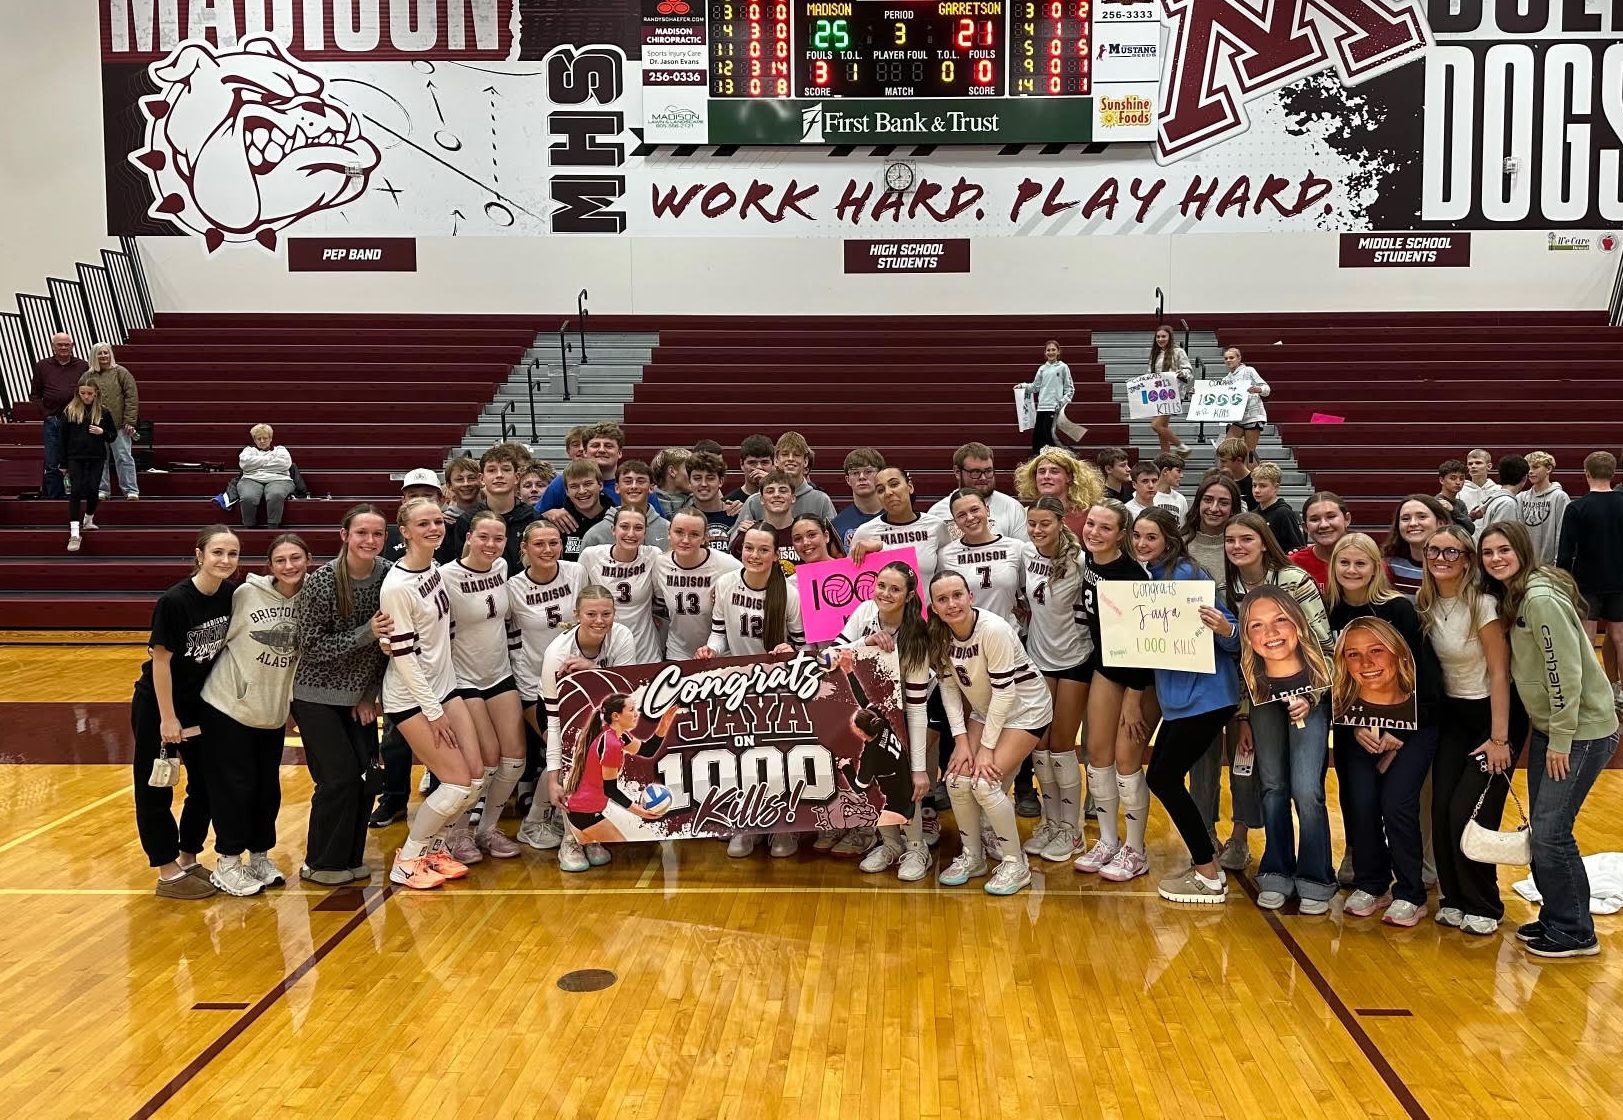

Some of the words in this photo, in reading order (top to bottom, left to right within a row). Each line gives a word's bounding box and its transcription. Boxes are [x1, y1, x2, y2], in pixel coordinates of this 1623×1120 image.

[724, 4, 733, 20] 3
[750, 4, 760, 20] 0
[776, 4, 787, 20] 0
[806, 3, 851, 16] MADISON
[884, 10, 914, 19] PERIOD
[937, 2, 1001, 16] GARRETSON
[1026, 3, 1034, 18] 3
[1052, 2, 1061, 18] 0
[1079, 2, 1089, 18] 2
[1102, 10, 1153, 18] 256-3333
[723, 24, 733, 37] 4
[751, 22, 760, 39] 3
[776, 22, 787, 39] 0
[814, 19, 849, 48] 25
[894, 22, 906, 44] 3
[958, 18, 992, 47] 21
[1024, 22, 1034, 36] 4
[718, 43, 733, 56] 11
[750, 41, 760, 58] 0
[776, 41, 787, 58] 0
[806, 50, 833, 60] FOULS
[840, 50, 863, 60] T.O.L.
[873, 50, 905, 60] PLAYER
[907, 50, 928, 60] FOUL
[936, 50, 960, 60] T.O.L.
[968, 50, 996, 60] FOULS
[1024, 40, 1034, 55] 5
[1051, 39, 1061, 55] 0
[1078, 39, 1088, 55] 5
[1108, 44, 1156, 54] MUSTANG
[718, 60, 733, 76] 12
[751, 60, 760, 76] 3
[771, 61, 787, 75] 14
[814, 59, 828, 83] 3
[941, 60, 955, 82] 0
[978, 60, 992, 82] 0
[1024, 59, 1034, 72] 9
[1051, 58, 1061, 73] 0
[649, 72, 700, 82] 256-0336
[1018, 79, 1034, 91] 14
[1051, 77, 1061, 93] 0
[718, 79, 734, 94] 13
[751, 78, 761, 94] 0
[777, 78, 787, 94] 8
[804, 87, 831, 96] SCORE
[885, 87, 914, 96] MATCH
[968, 86, 995, 96] SCORE
[1101, 98, 1150, 110] Sunshine
[824, 111, 870, 132] First
[874, 111, 928, 132] Bank
[931, 116, 946, 132] &
[946, 112, 1000, 132] Trust
[1118, 111, 1150, 123] Foods
[546, 43, 627, 236] MHS
[652, 179, 820, 223] WORK
[833, 177, 984, 225] HARD.
[1010, 177, 1167, 223] PLAY
[1179, 169, 1332, 221] HARD.
[870, 243, 897, 255] HIGH
[900, 243, 945, 255] SCHOOL
[1358, 238, 1403, 249] MIDDLE
[1406, 238, 1452, 249] SCHOOL
[322, 248, 346, 260] PEP
[348, 248, 382, 260] BAND
[1373, 251, 1436, 262] STUDENTS
[878, 257, 937, 268] STUDENTS
[1156, 402, 1181, 415] KILLS
[881, 531, 928, 544] MADISON
[958, 550, 1006, 564] MADISON
[601, 562, 646, 577] MADISON
[976, 566, 992, 589] 7
[1028, 561, 1067, 579] MADISN
[1084, 569, 1103, 586] MADISO
[419, 570, 441, 598] MADISON
[460, 573, 504, 593] MADISON
[667, 575, 711, 587] MADISON
[526, 584, 572, 605] MADISON
[617, 582, 632, 602] 3
[1033, 581, 1046, 606] 4
[1132, 582, 1176, 604] Congrats
[434, 590, 450, 620] 10
[485, 594, 498, 619] 1
[674, 591, 701, 615] 13
[732, 593, 764, 610] MADIS
[249, 607, 299, 623] BRISTOL
[545, 604, 562, 629] 5
[1132, 604, 1181, 633] Jaya
[739, 613, 764, 638] 12
[1172, 638, 1197, 656] KILLS
[643, 650, 821, 719] Congrats
[677, 693, 813, 742] JAYA
[733, 734, 756, 747] ON
[656, 743, 837, 814] 1000
[688, 778, 808, 837] Kills!
